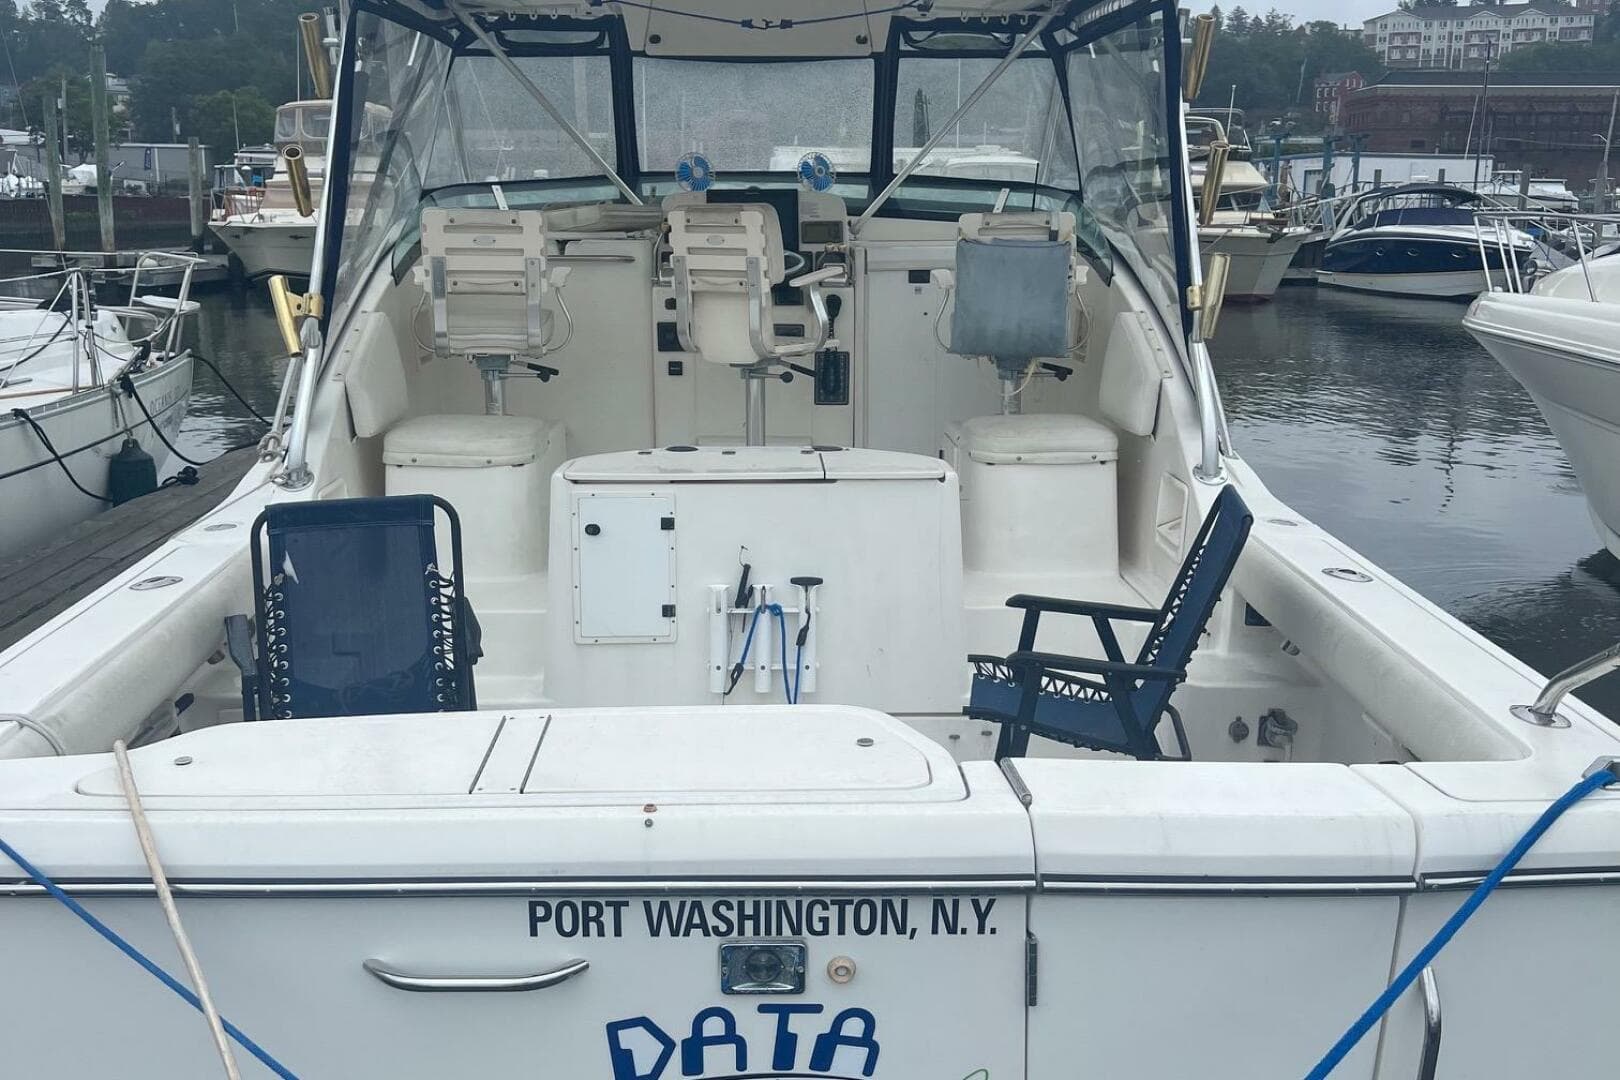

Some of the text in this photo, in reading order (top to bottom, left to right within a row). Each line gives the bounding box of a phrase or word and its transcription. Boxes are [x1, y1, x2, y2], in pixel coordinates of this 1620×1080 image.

[528, 897, 997, 941] PORT WASHINGTON, N.Y.
[606, 1003, 880, 1080] DATA
